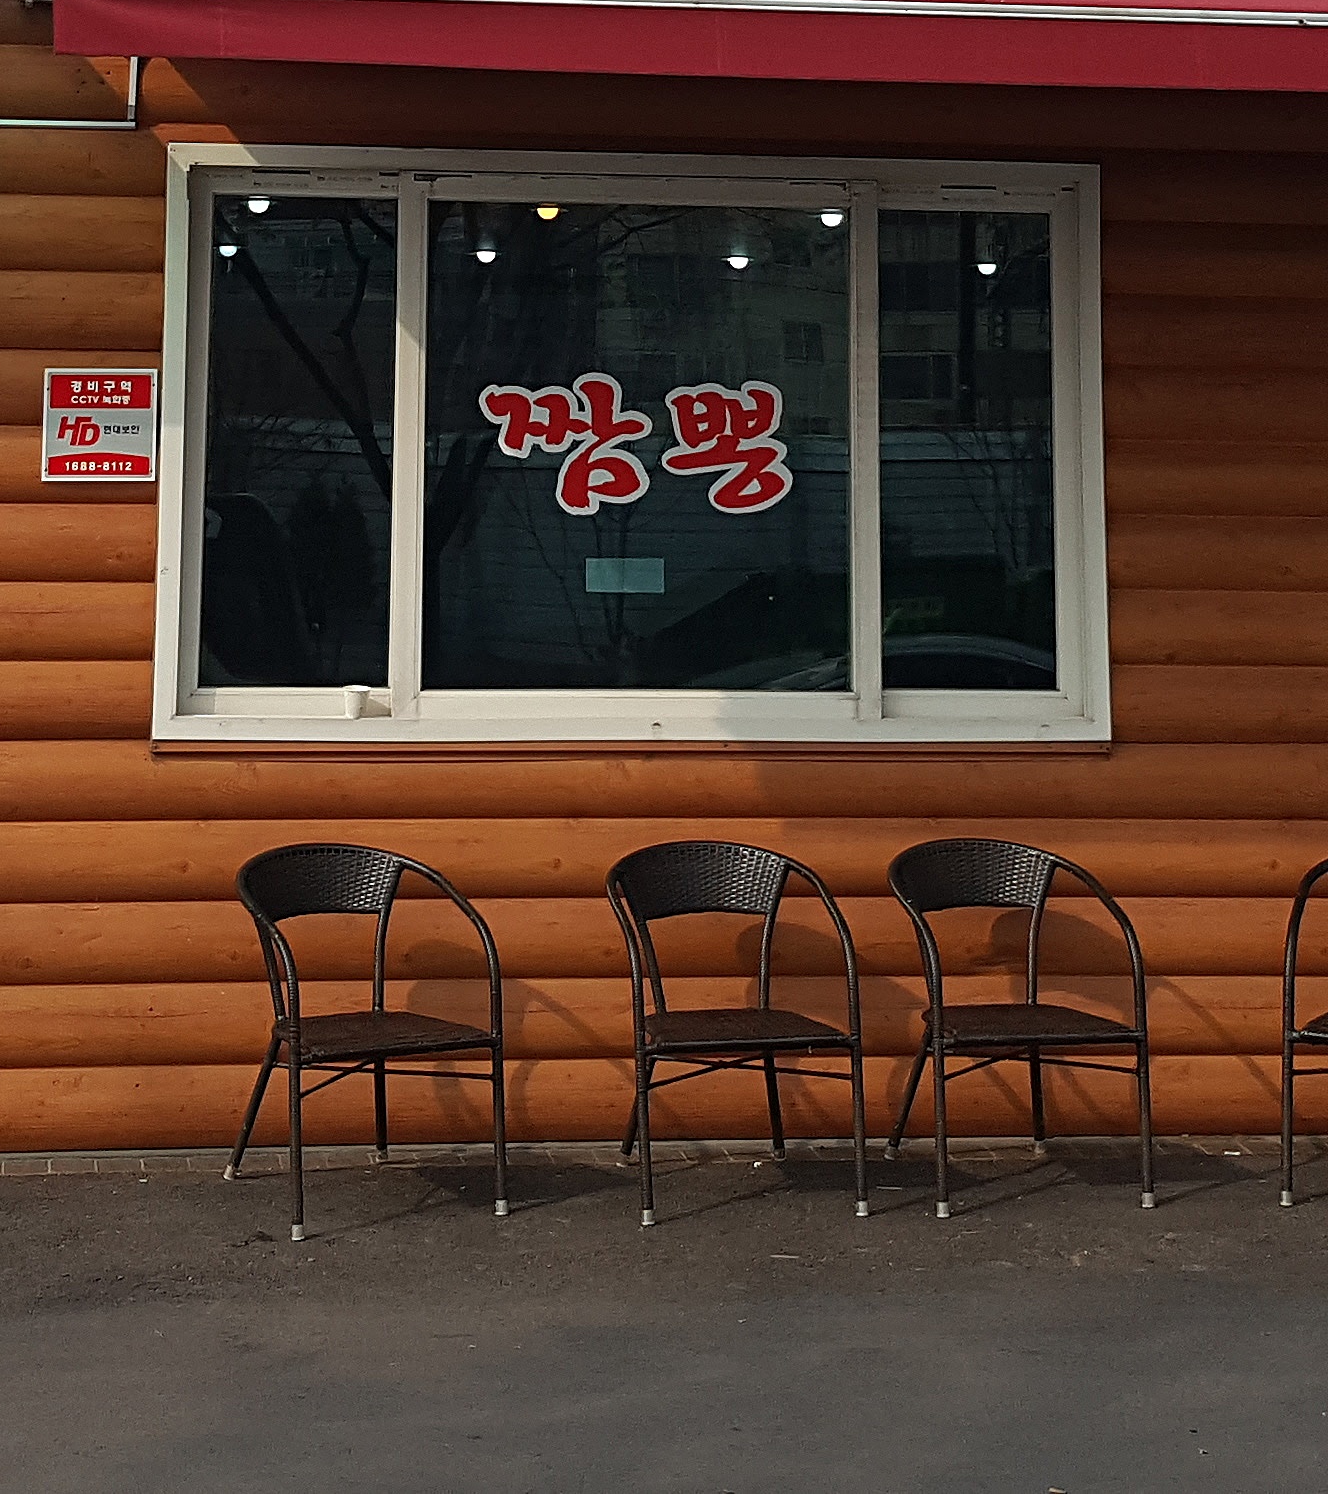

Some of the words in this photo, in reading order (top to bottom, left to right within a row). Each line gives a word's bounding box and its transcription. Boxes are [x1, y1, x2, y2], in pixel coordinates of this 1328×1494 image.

[71, 395, 99, 404] CCTV
[479, 372, 793, 515] 짬뽕
[65, 461, 132, 471] 1688-8112
